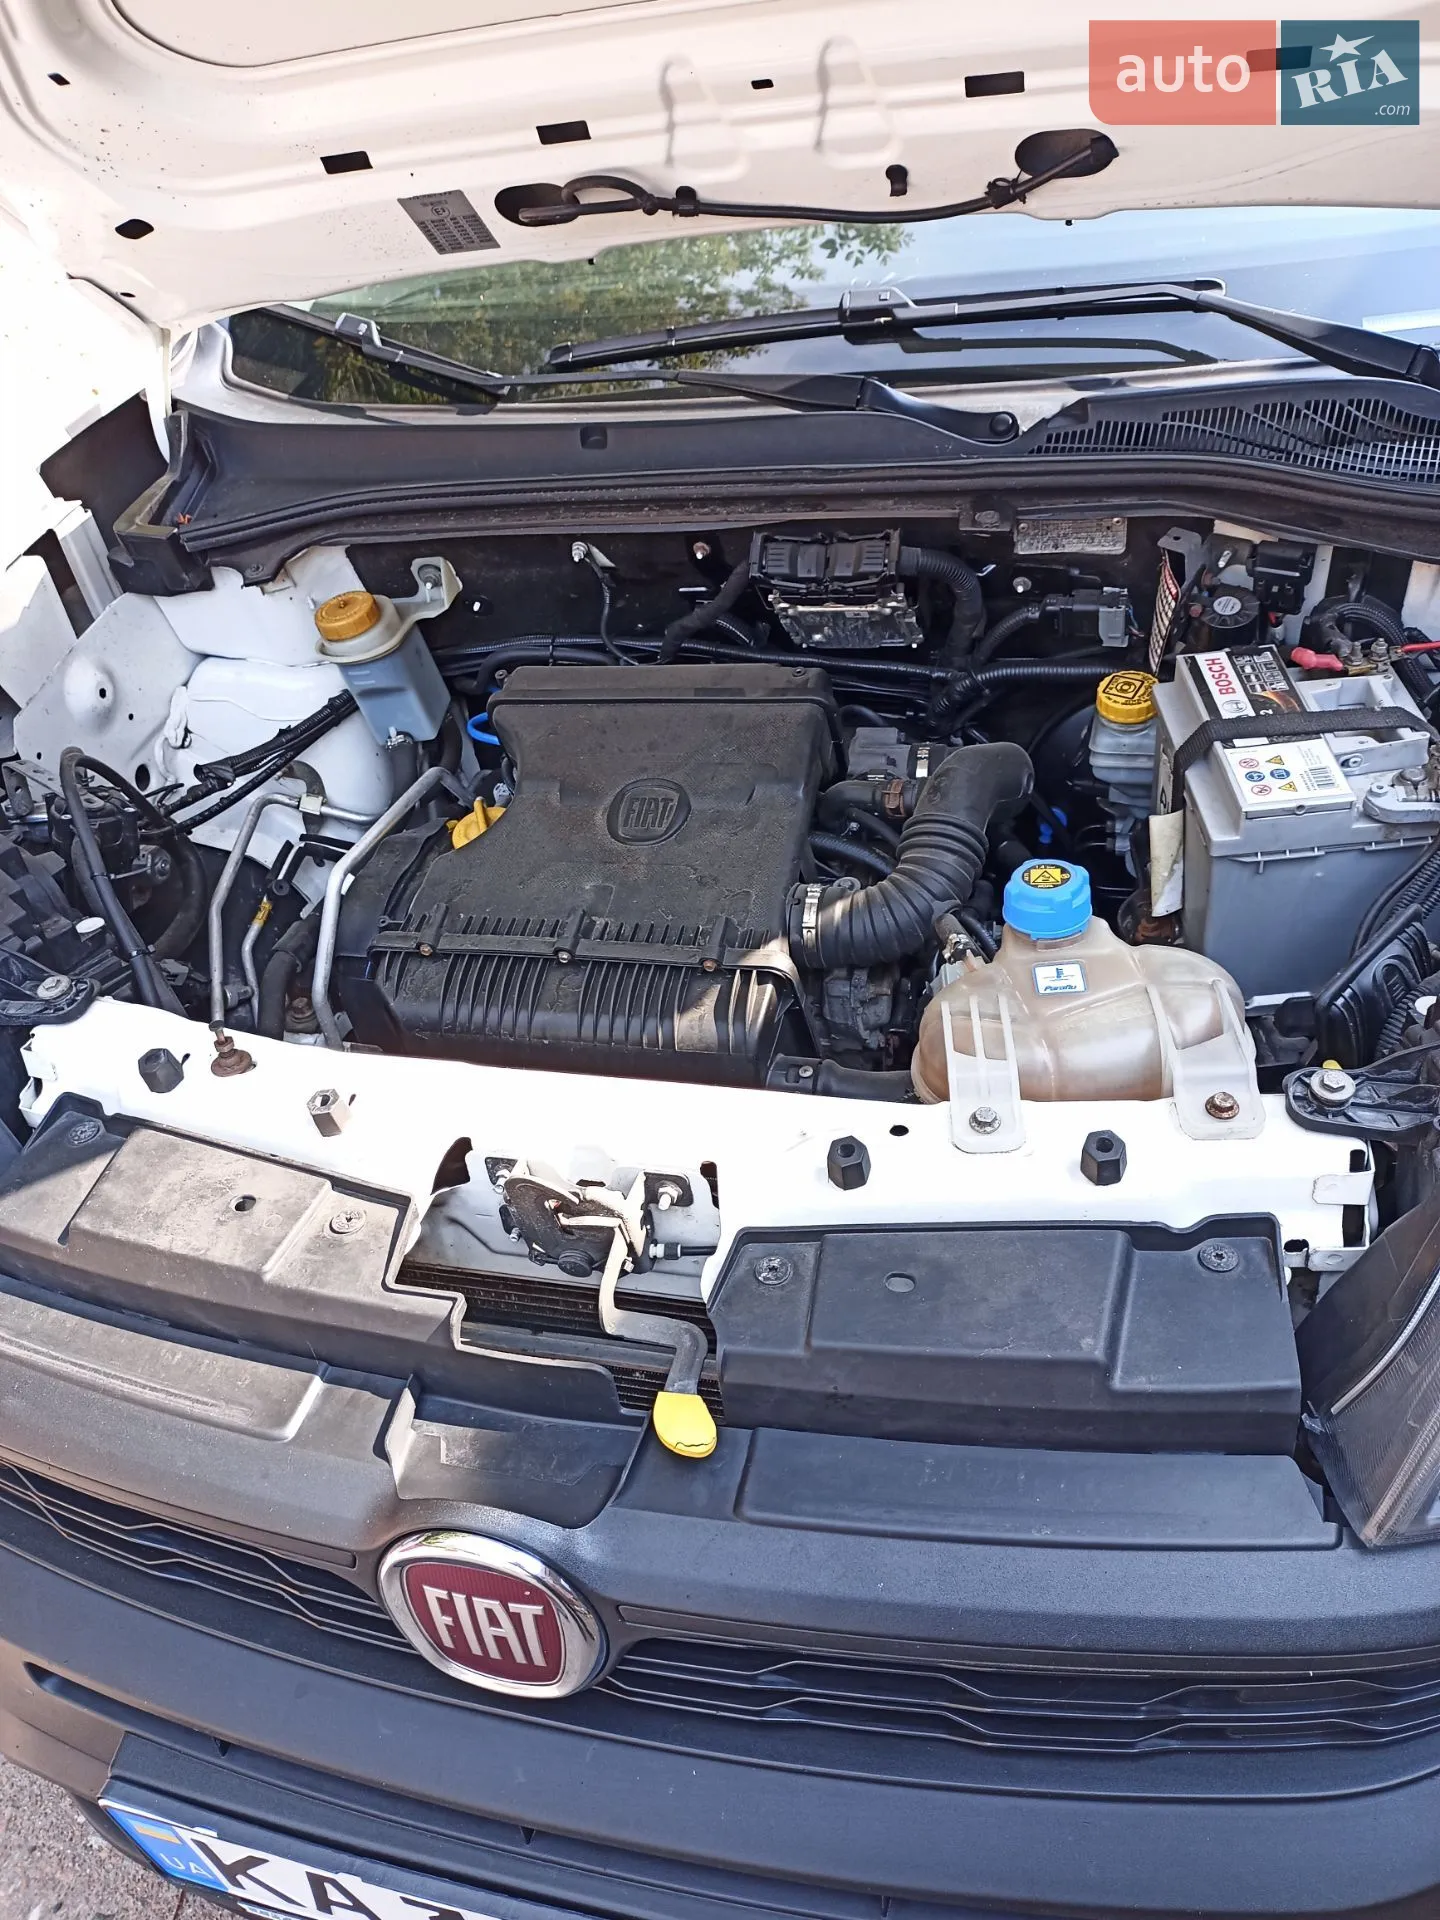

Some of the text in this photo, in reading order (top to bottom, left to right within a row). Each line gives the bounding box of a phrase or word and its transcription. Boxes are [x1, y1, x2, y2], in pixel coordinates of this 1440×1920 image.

[1204, 657, 1237, 696] BOSCH
[623, 797, 674, 828] FIAT
[422, 1585, 548, 1667] FIAT
[160, 1853, 214, 1880] UA
[191, 1838, 380, 1920] KA
